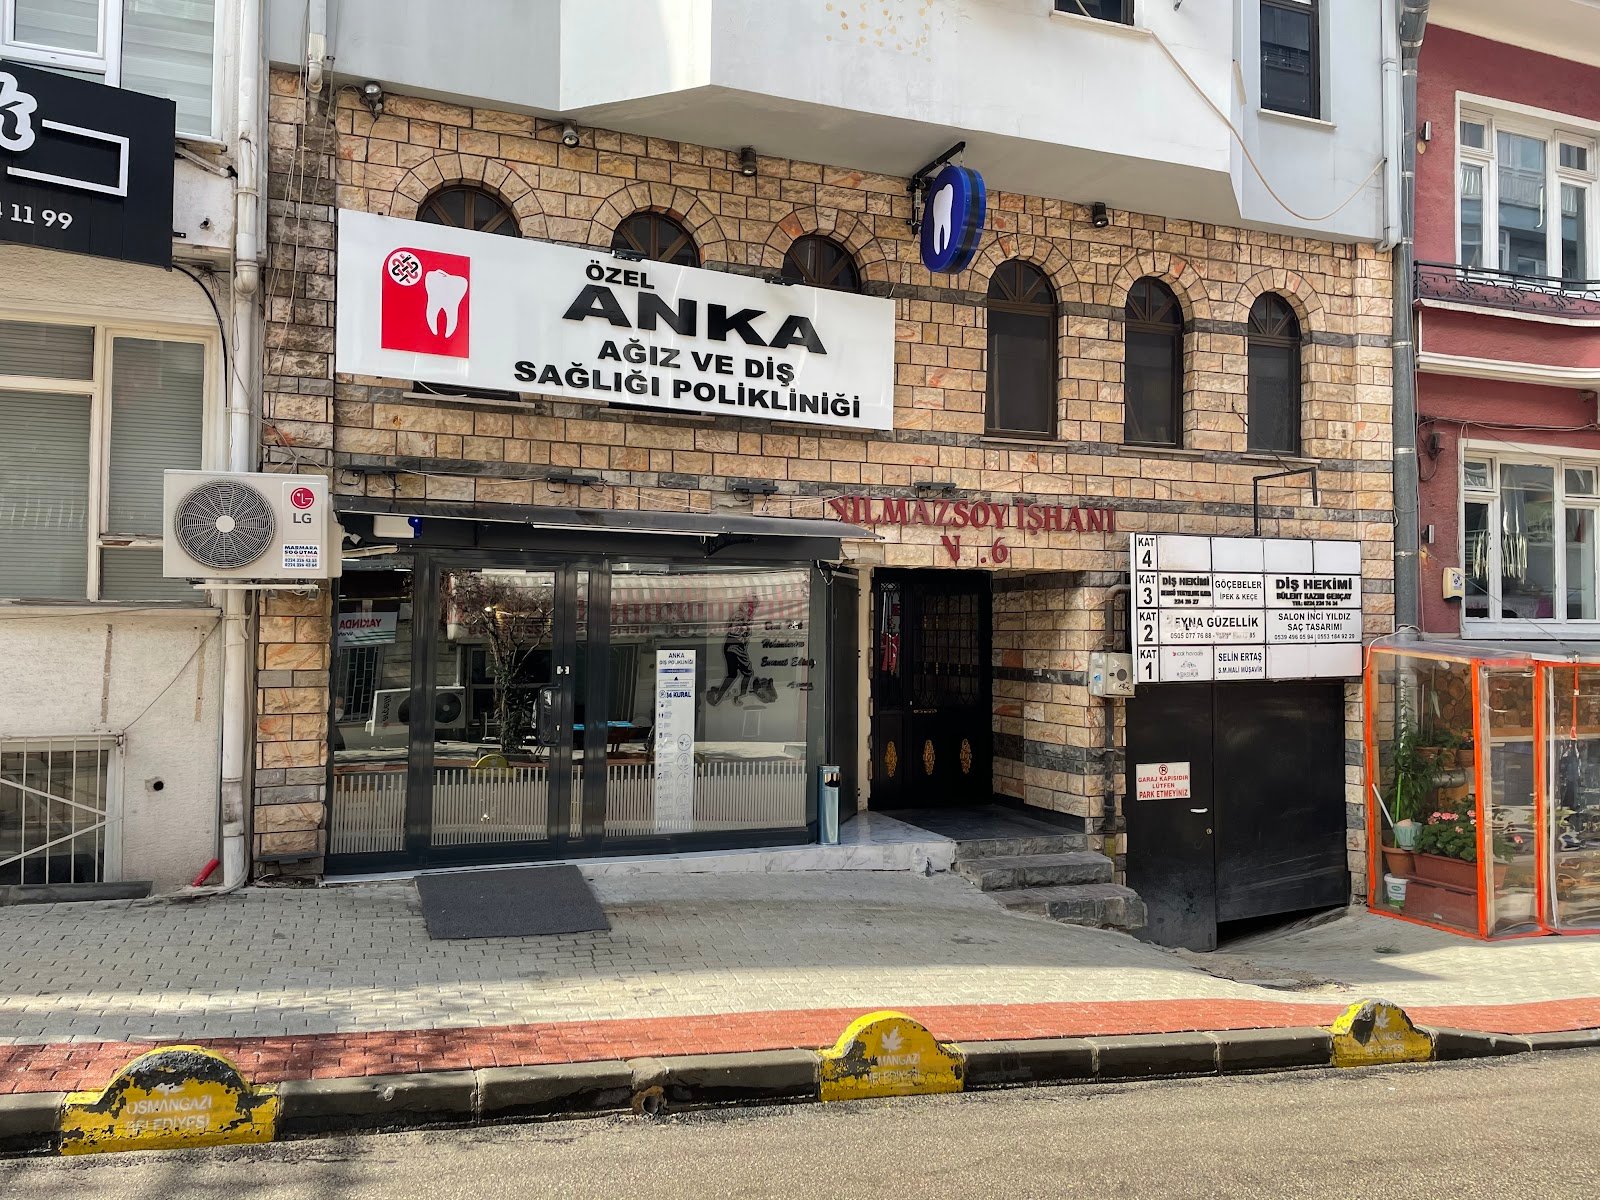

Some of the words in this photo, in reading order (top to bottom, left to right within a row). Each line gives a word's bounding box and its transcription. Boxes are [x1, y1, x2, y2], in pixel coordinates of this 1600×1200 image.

[11, 203, 34, 224] 11
[42, 209, 73, 229] 99
[585, 259, 655, 289] ÖZEL
[562, 284, 828, 354] ANKA
[597, 337, 681, 368] AĞIZ
[691, 351, 734, 375] VE
[745, 356, 795, 387] DİŞ
[514, 361, 660, 397] SAĞLIĞI
[673, 379, 860, 418] POLİKLİNİĞİ
[293, 512, 312, 524] LG
[828, 495, 1009, 529] YILMAZSOY
[1138, 537, 1155, 547] KAT
[1142, 549, 1152, 567] 4
[1139, 574, 1156, 585] KAT
[1162, 576, 1177, 588] DİŞ
[1179, 576, 1210, 586] HEKİMİ
[1215, 579, 1262, 590] GÖÇEBELER
[1276, 577, 1300, 592] DİŞ
[1303, 577, 1353, 590] HEKİMİ
[1143, 587, 1153, 605] 3
[1241, 593, 1258, 601] KEÇE
[1326, 592, 1352, 601] GENÇAY
[1139, 612, 1157, 621] KAT
[1207, 614, 1259, 628] GÜZELLİK
[1278, 613, 1305, 621] SALON
[1307, 611, 1324, 620] İNCİ
[1143, 624, 1154, 642] 2
[1287, 623, 1303, 632] SAÇ
[1305, 623, 1342, 631] TASARIMI
[1140, 649, 1157, 659] KAT
[1218, 651, 1238, 662] SELİN
[1240, 652, 1263, 663] ERTAŞ
[1145, 662, 1152, 680] 1
[1139, 790, 1155, 799] PARK
[1156, 789, 1188, 798] ETMEYİNİZ
